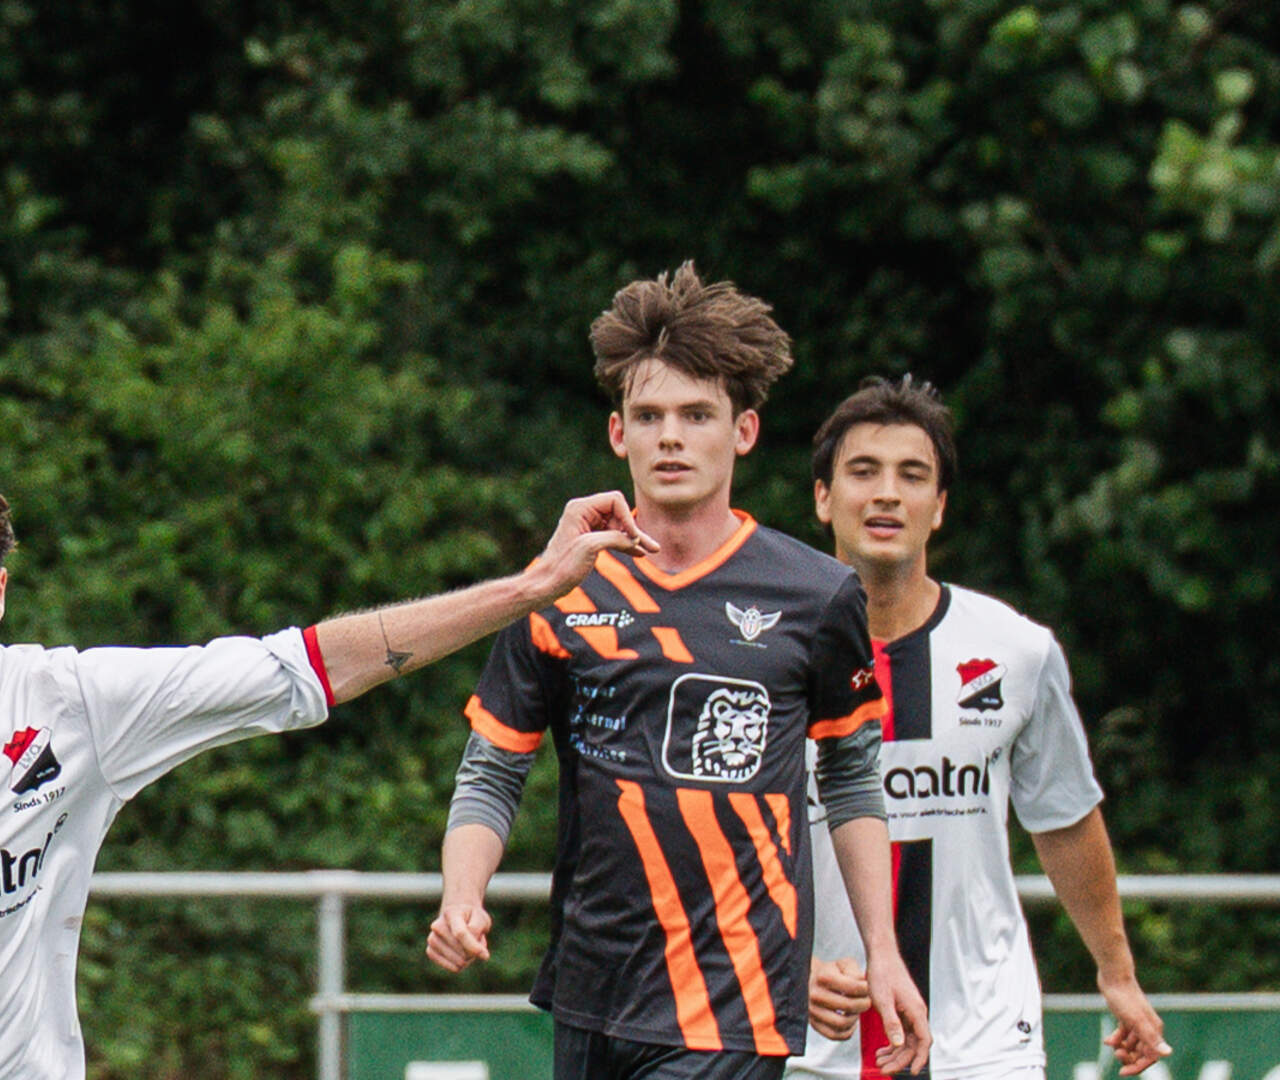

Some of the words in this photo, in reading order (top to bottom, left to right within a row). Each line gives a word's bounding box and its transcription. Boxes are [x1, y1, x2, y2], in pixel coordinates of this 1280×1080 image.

[565, 613, 619, 627] CRAFT
[13, 797, 42, 813] Sinds
[43, 786, 66, 803] 1917
